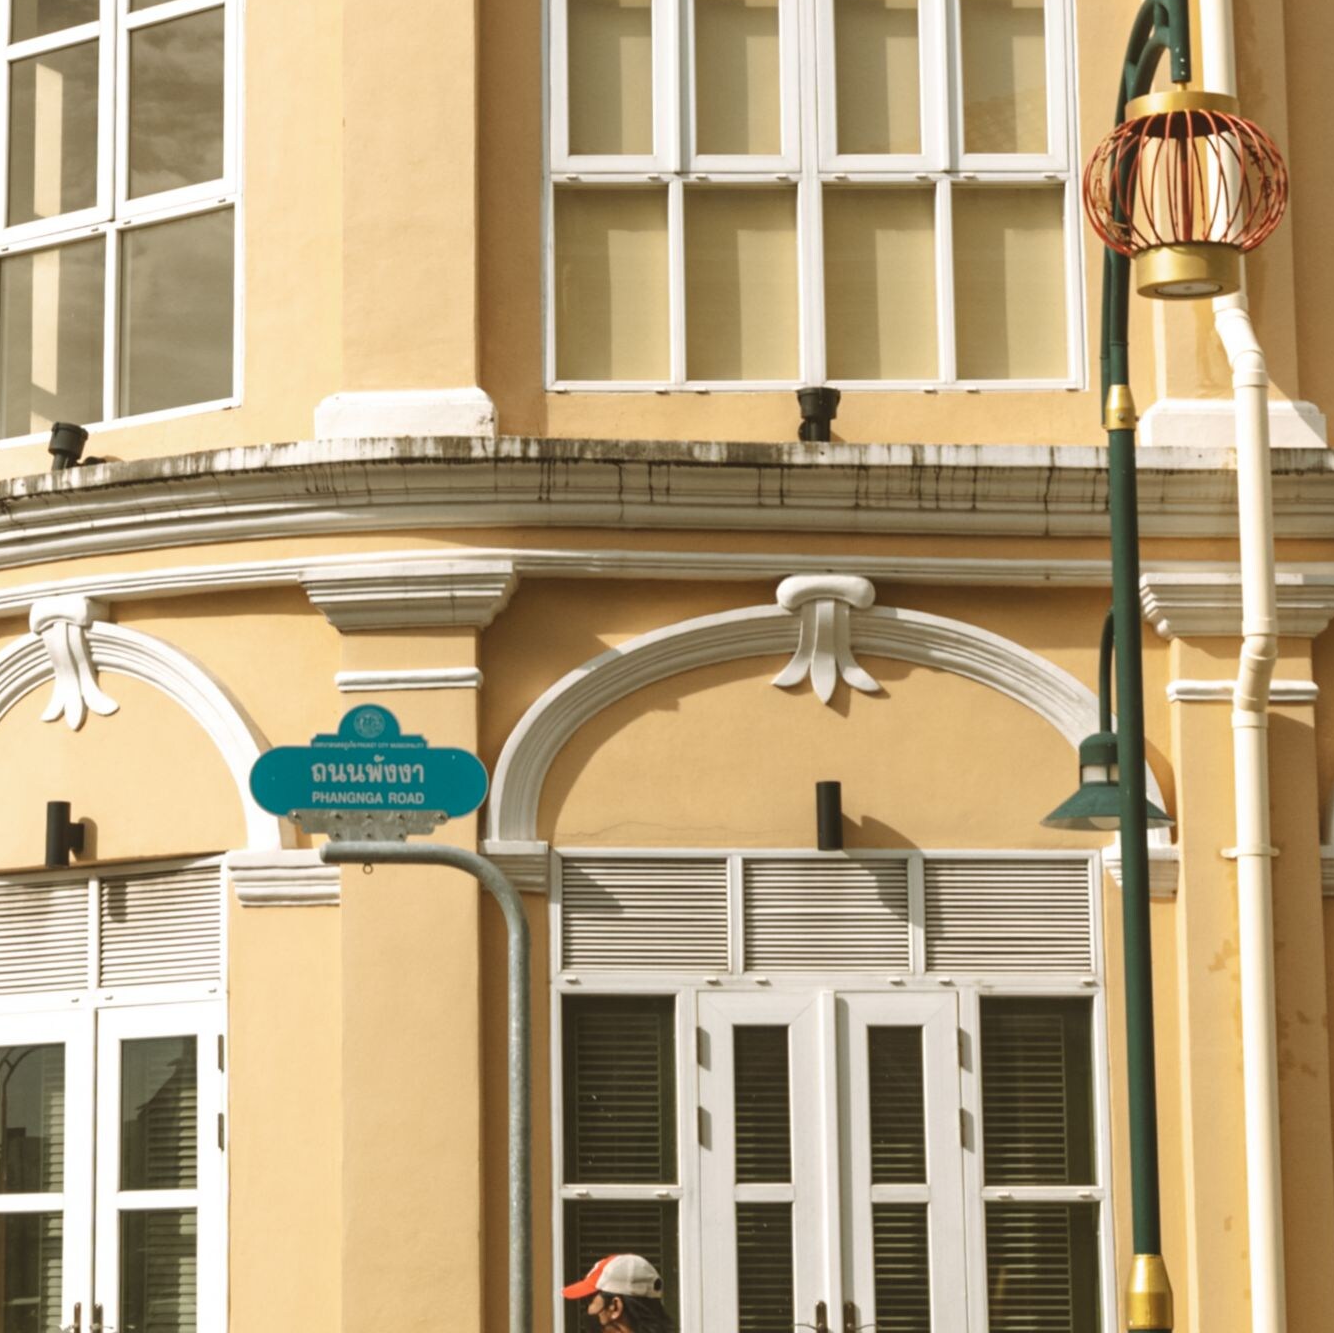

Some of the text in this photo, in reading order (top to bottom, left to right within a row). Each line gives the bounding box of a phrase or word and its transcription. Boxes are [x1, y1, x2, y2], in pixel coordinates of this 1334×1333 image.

[311, 754, 424, 783] ถนนพังงา
[312, 792, 424, 804] PHANGNGA ROAD
